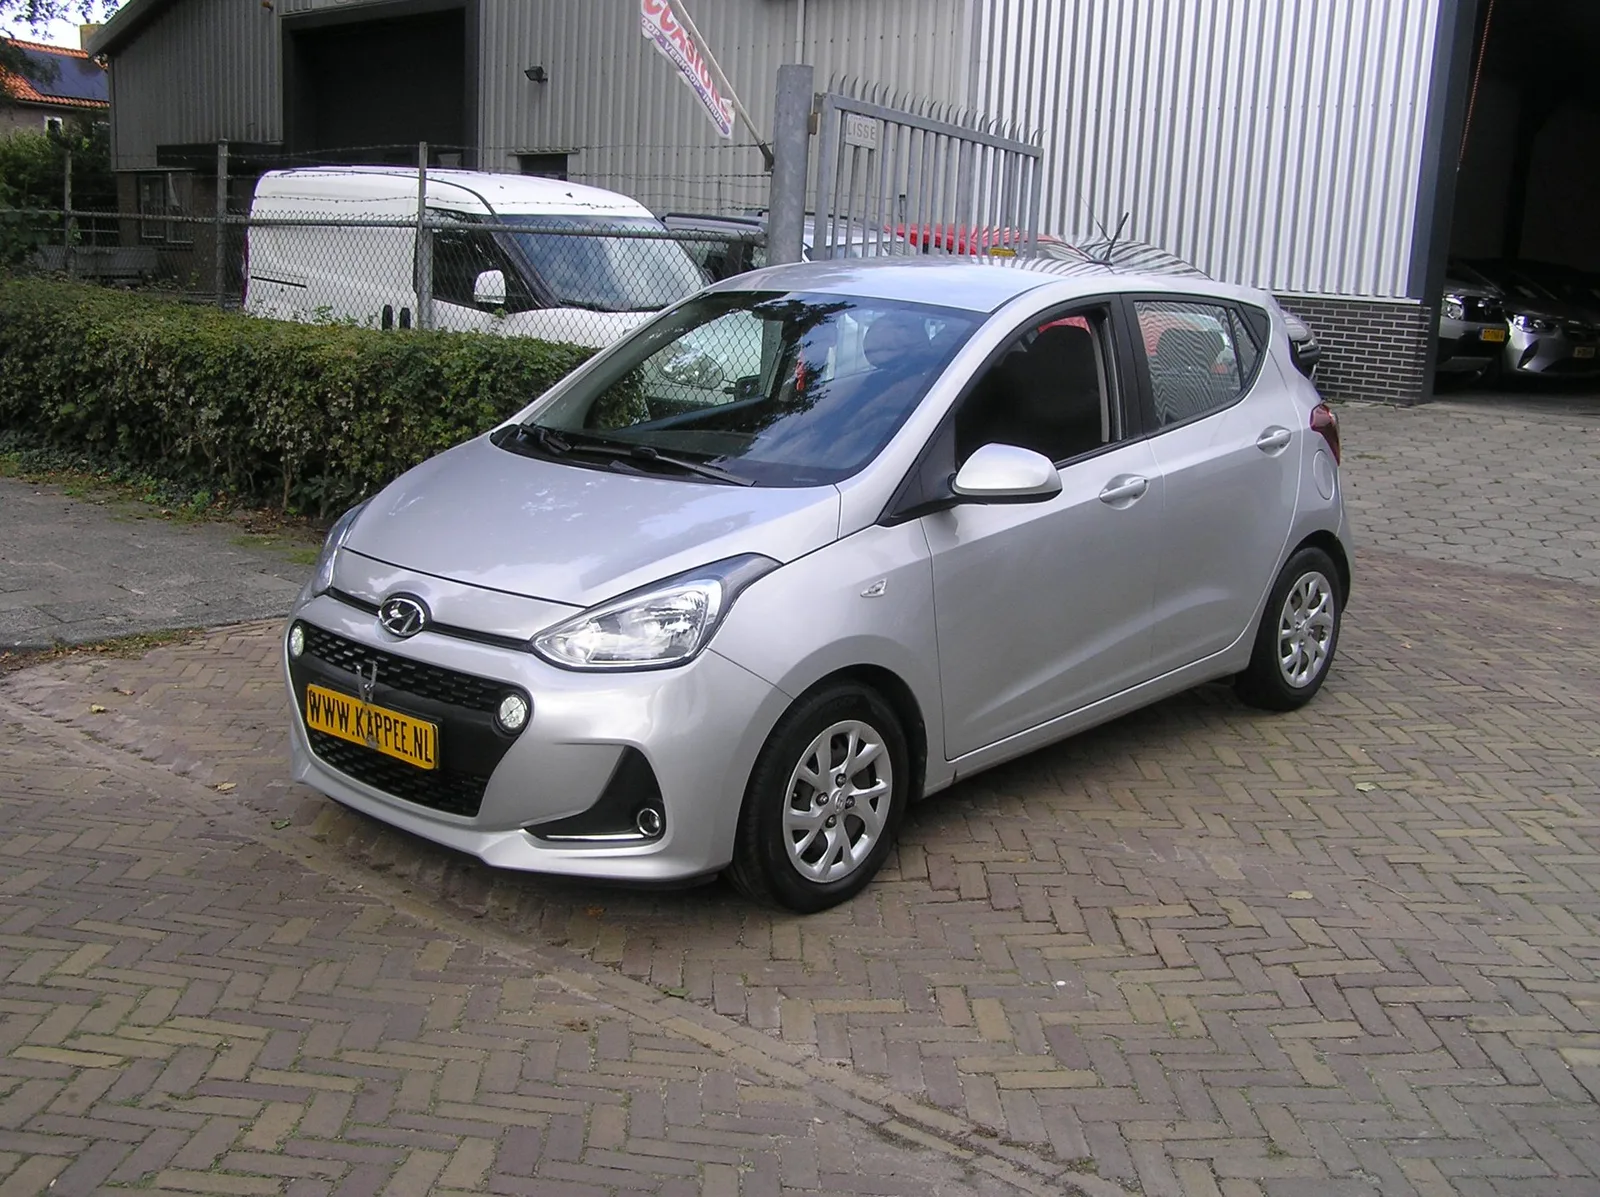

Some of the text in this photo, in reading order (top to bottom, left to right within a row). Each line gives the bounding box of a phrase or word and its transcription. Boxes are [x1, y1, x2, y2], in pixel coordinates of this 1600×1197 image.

[664, 41, 700, 87] VERKOOP
[702, 93, 725, 124] INRUIL
[847, 120, 876, 140] LISSE
[309, 690, 433, 763] WWW.KAPPEE.NL
